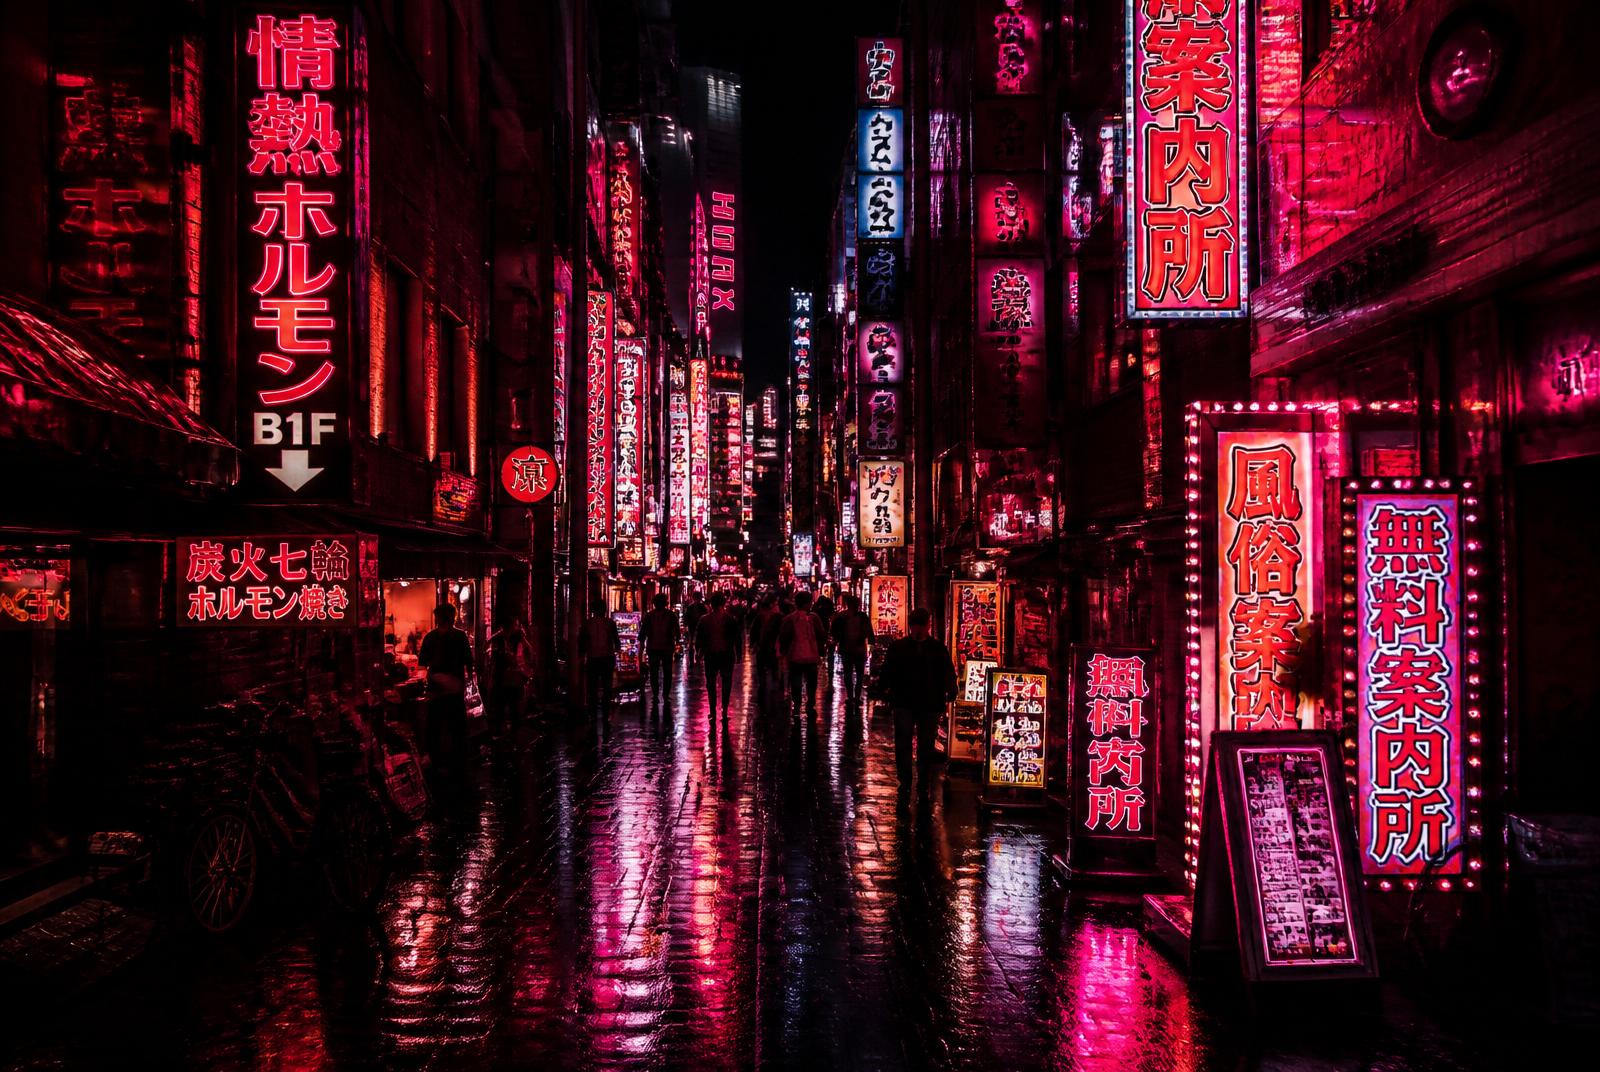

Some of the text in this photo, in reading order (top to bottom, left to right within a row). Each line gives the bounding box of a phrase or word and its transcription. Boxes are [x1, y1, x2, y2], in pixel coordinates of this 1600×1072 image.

[246, 15, 342, 405] 情熱ホルモン
[1141, 0, 1235, 302] 案内所
[253, 412, 337, 446] B1F
[186, 540, 350, 582] 炭火七輪
[186, 584, 350, 621] ホルモン焼き
[1369, 504, 1451, 866] 無料案内所
